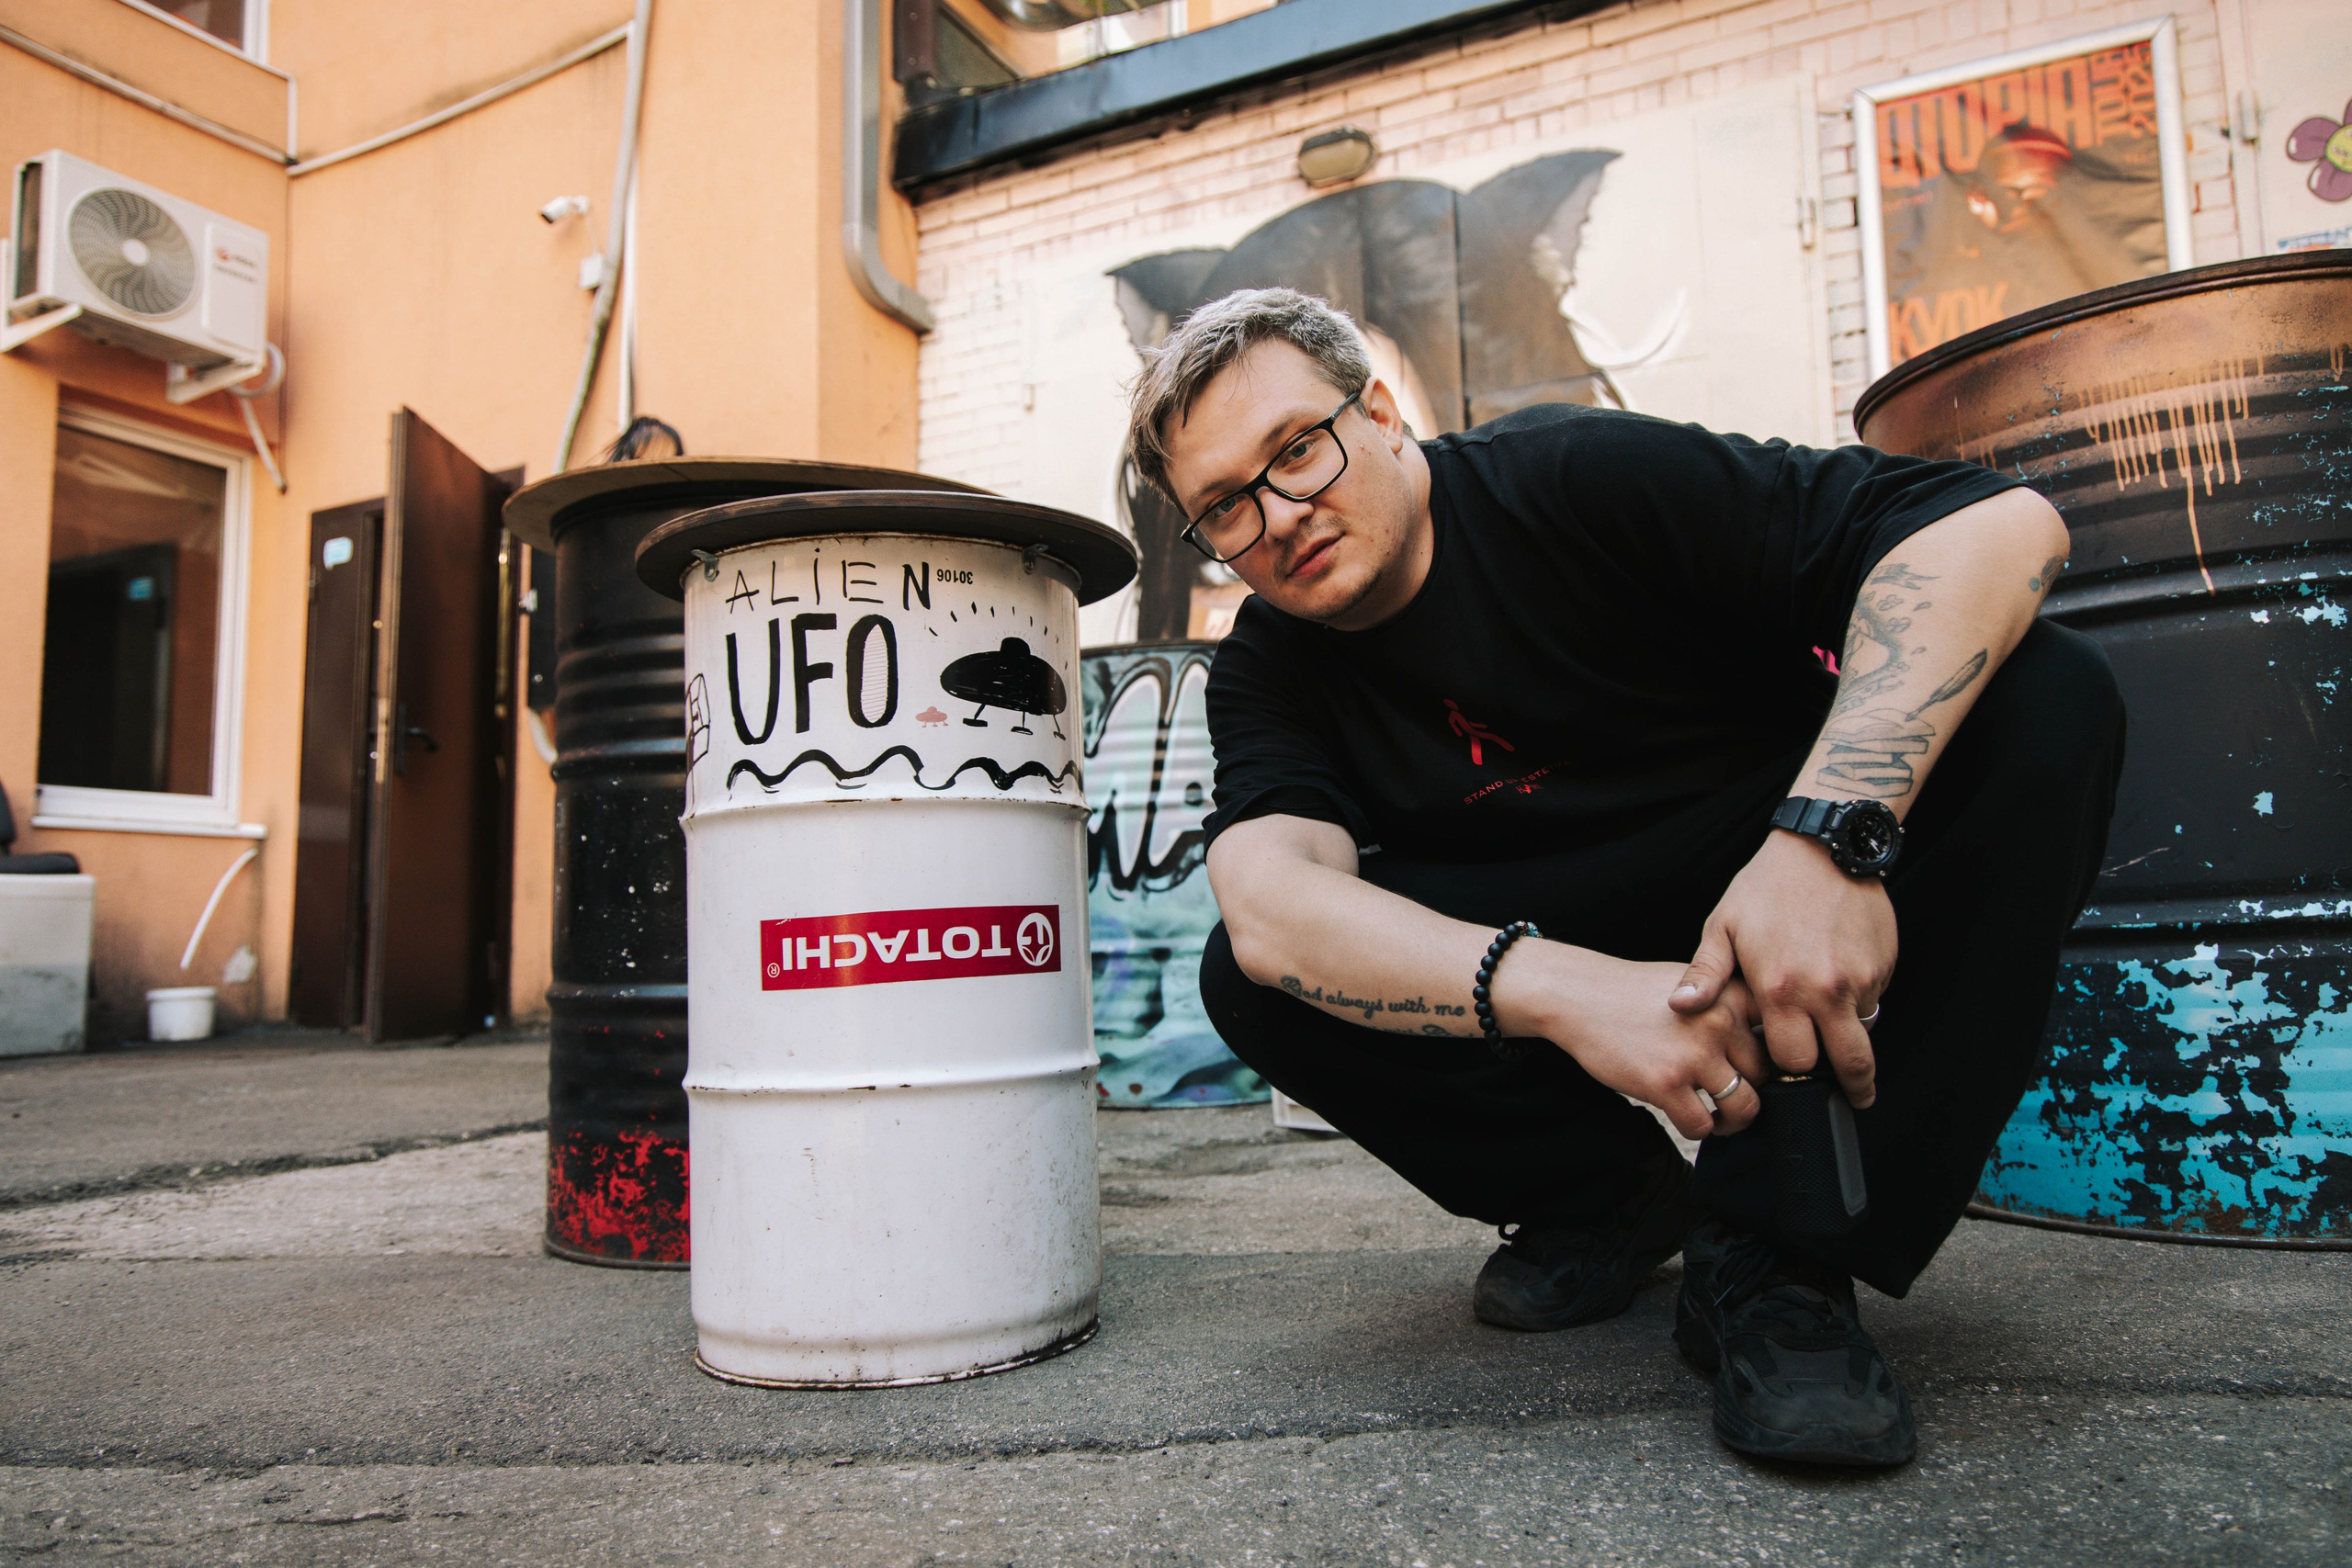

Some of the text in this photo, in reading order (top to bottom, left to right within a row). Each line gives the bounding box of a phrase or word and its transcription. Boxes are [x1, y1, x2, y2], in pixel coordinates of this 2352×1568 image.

[937, 568, 974, 584] 30106
[726, 613, 899, 745] UFO
[1464, 780, 1504, 805] STAND
[782, 924, 1012, 971] TOTACHI
[1326, 990, 1384, 1020] always
[1388, 996, 1430, 1013] with
[1434, 1004, 1466, 1016] me
